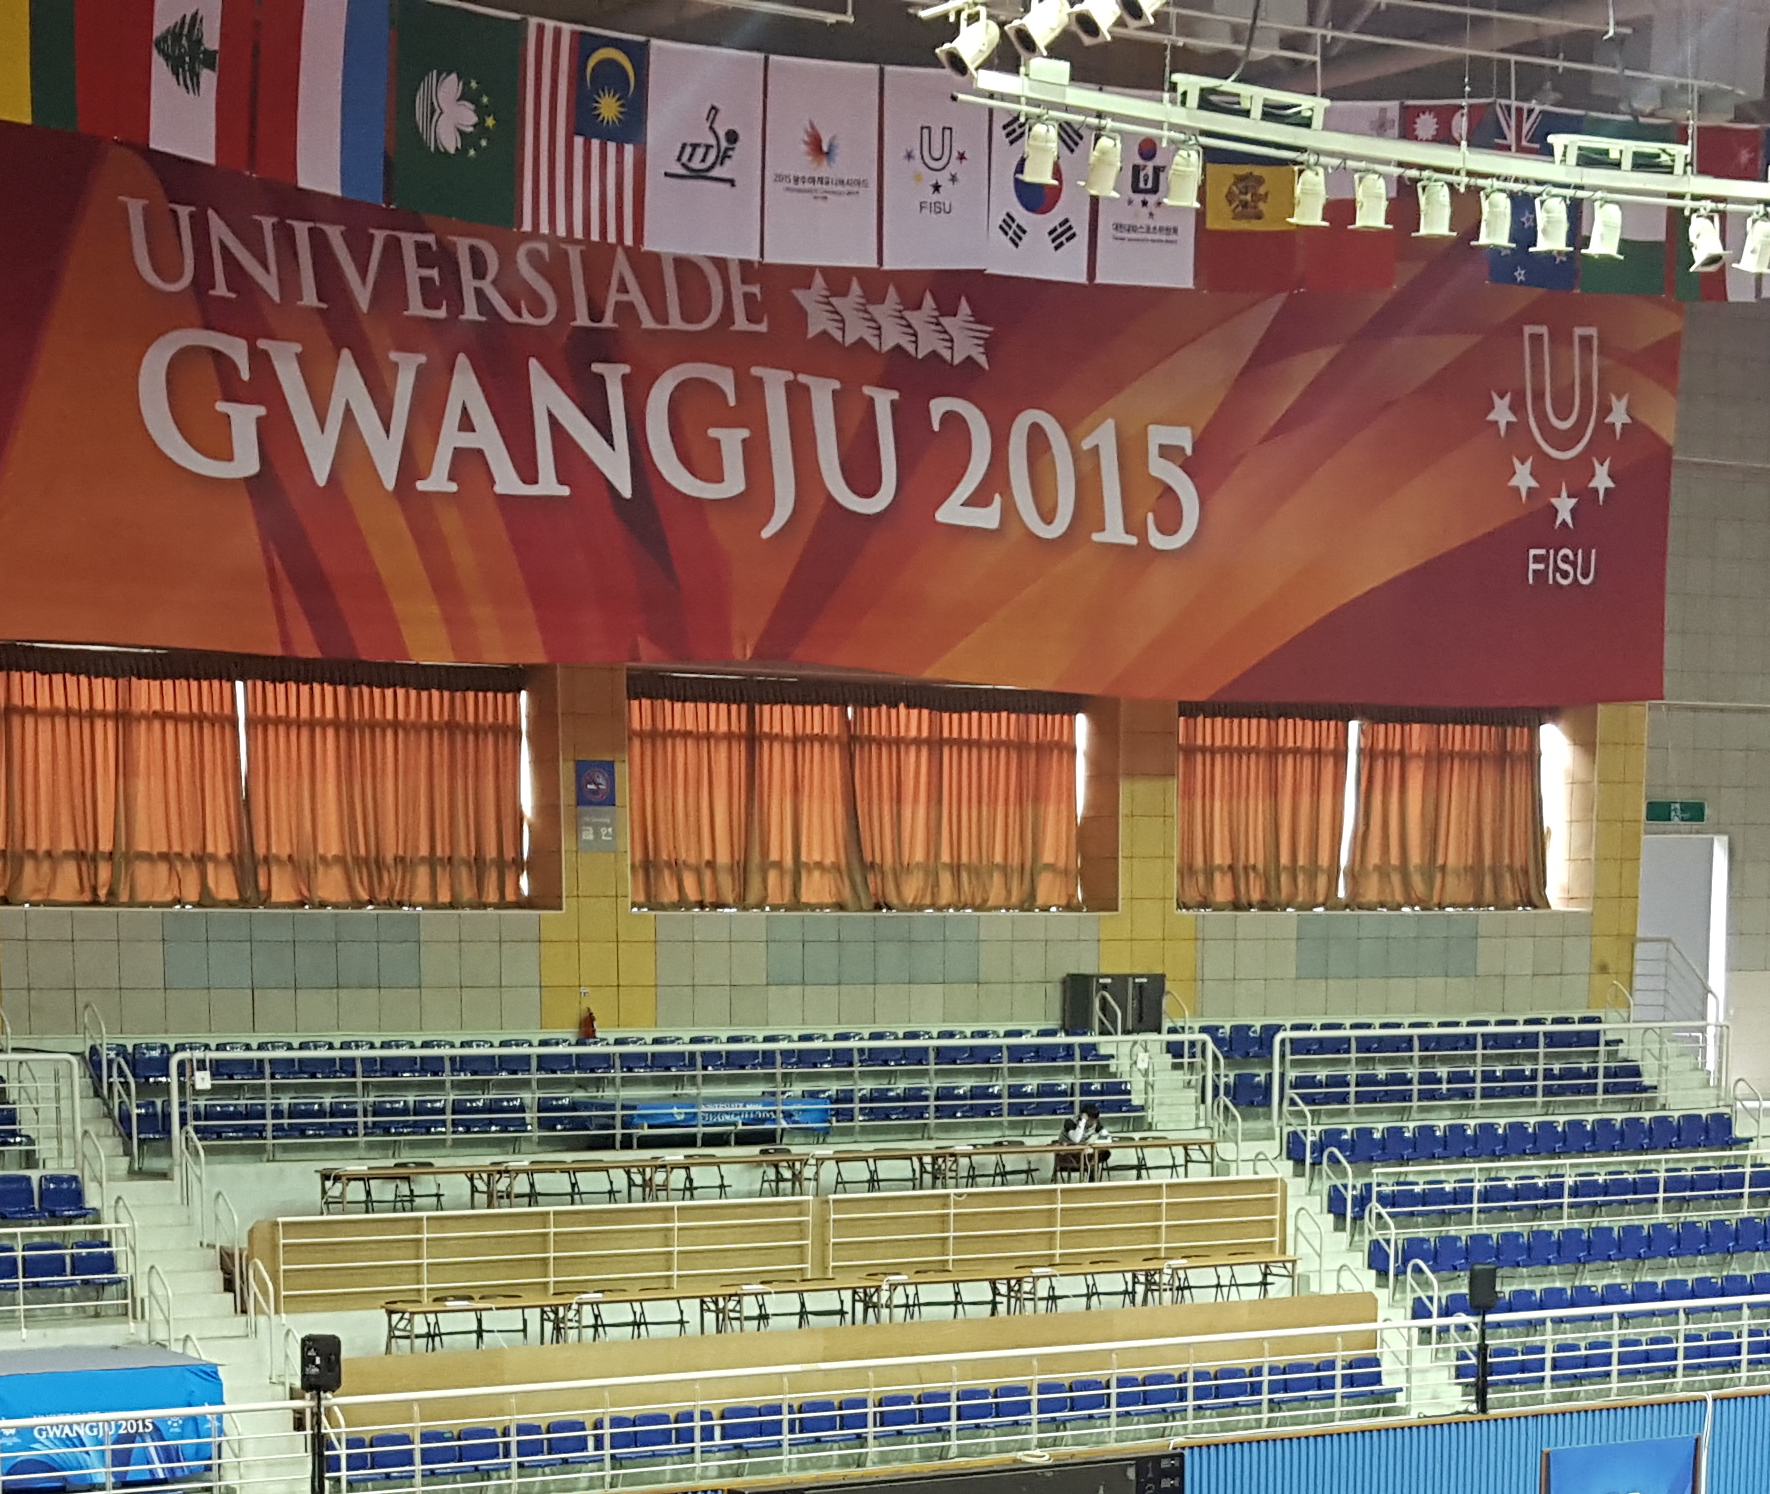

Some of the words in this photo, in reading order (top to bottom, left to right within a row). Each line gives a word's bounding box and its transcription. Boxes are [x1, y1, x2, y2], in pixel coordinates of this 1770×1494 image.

[676, 143, 737, 167] ITTF
[919, 201, 953, 214] FISU
[119, 195, 770, 334] UNIVERSIADE
[138, 326, 899, 539] GWANGJU
[929, 395, 1199, 551] 2015
[1527, 548, 1597, 588] FISU
[117, 1418, 154, 1434] 2015
